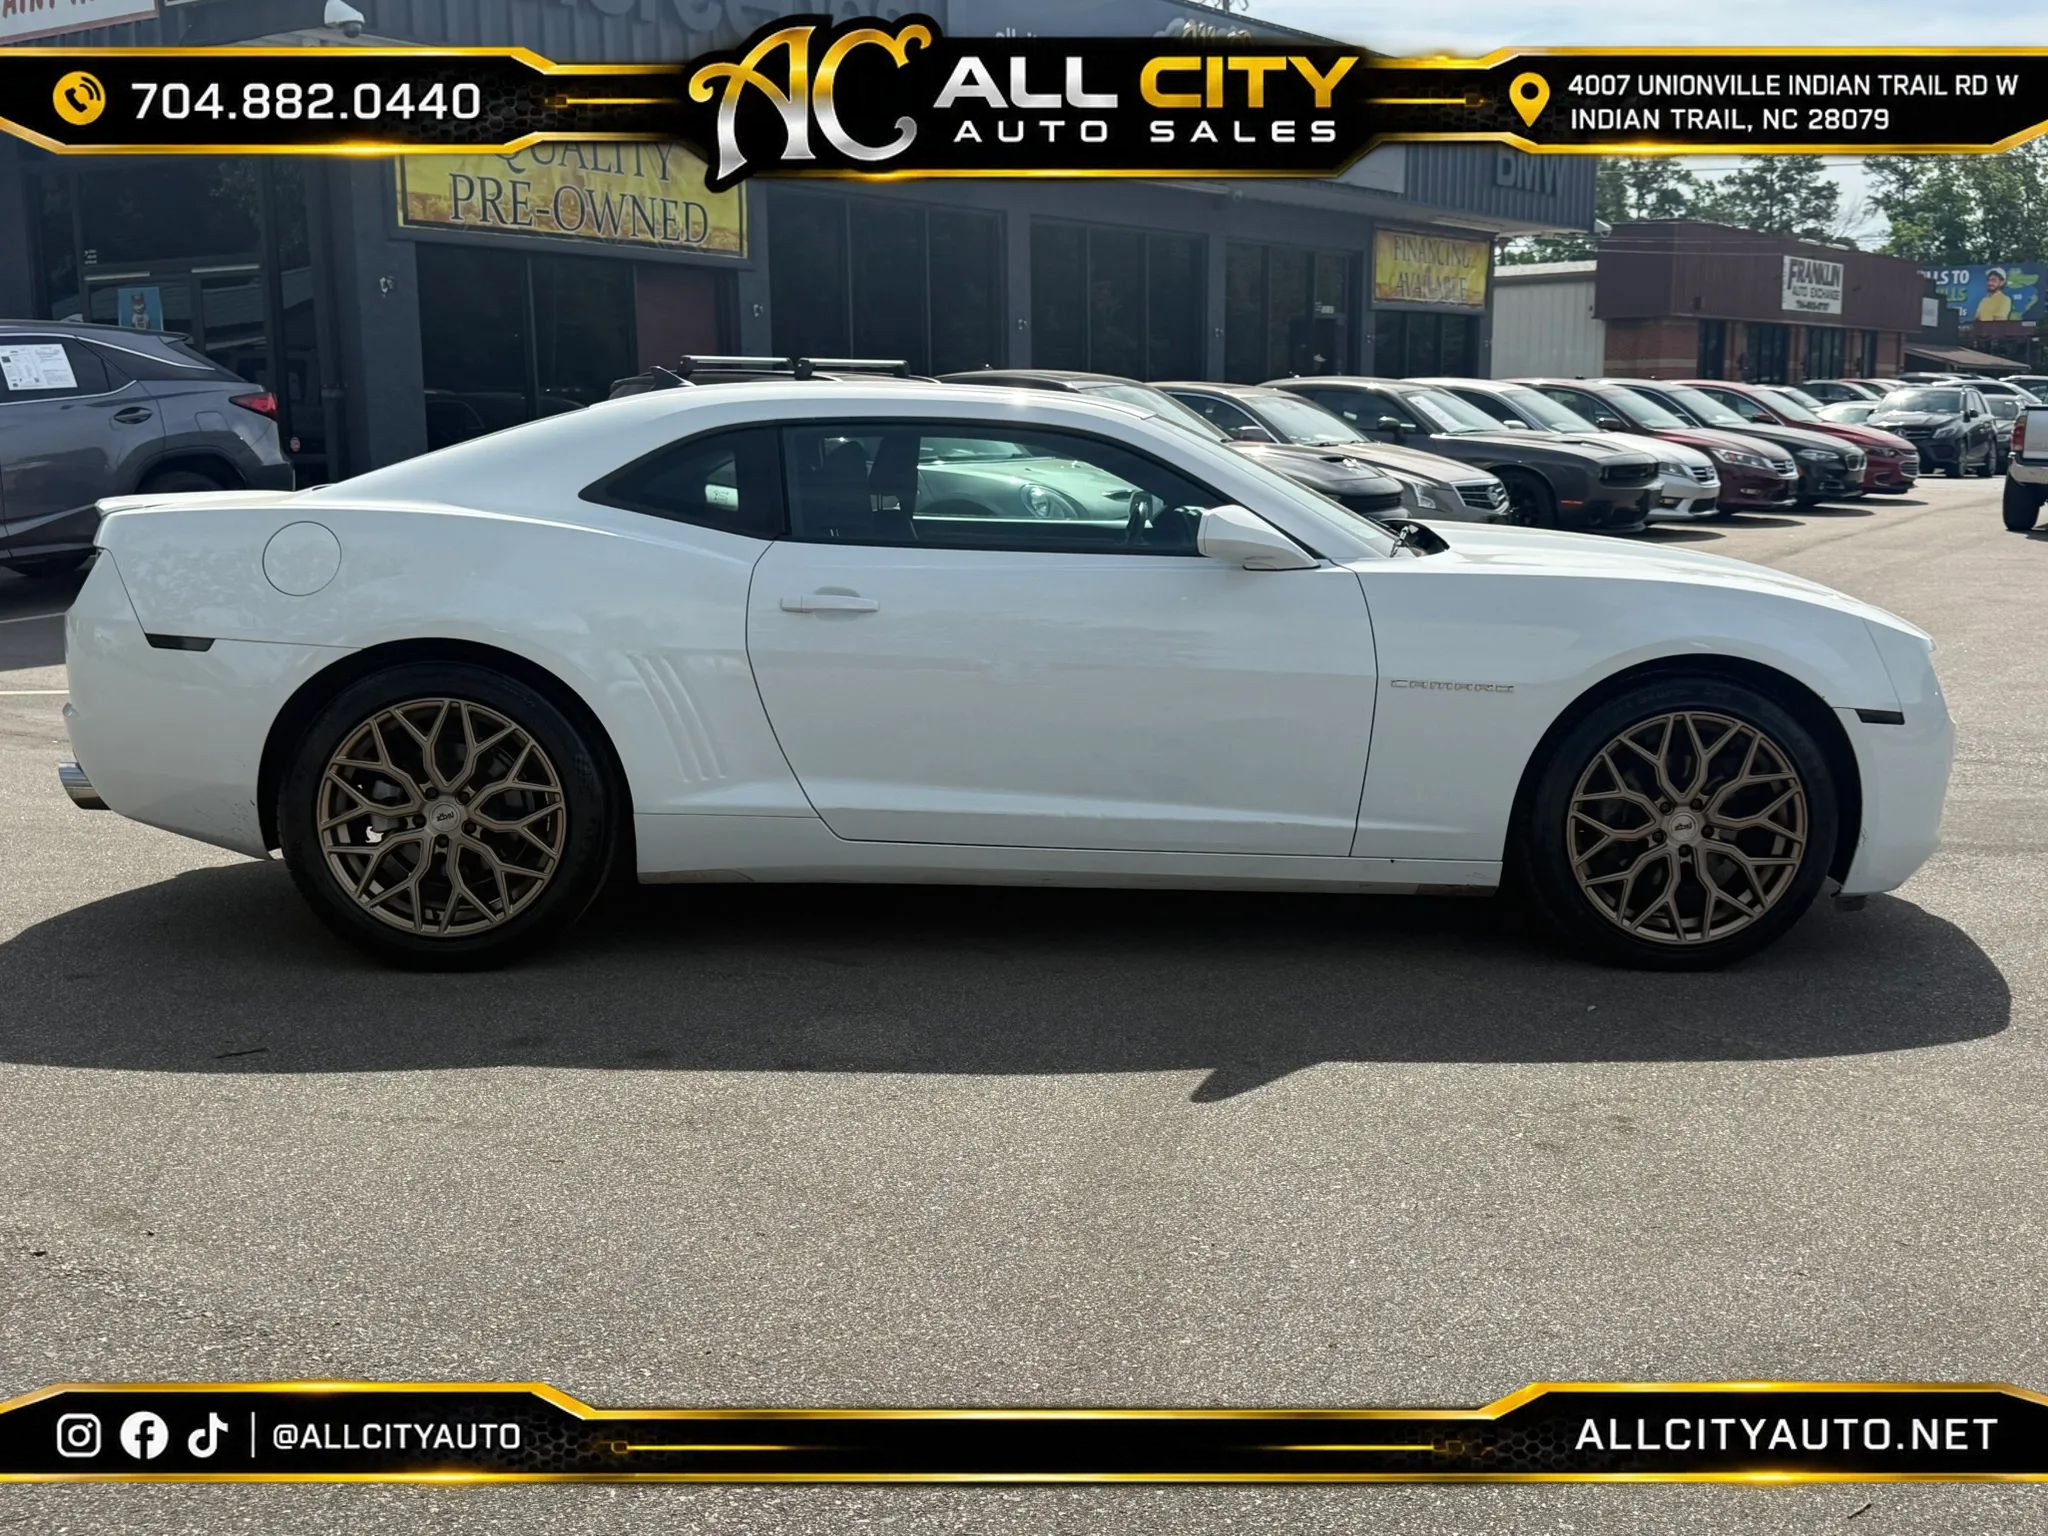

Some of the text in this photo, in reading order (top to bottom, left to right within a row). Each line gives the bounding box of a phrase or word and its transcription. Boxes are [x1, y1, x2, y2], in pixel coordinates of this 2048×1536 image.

[449, 173, 709, 245] PRE-OWNED
[1393, 235, 1470, 268] FINANCING
[1787, 258, 1841, 290] FRANKLIN
[1951, 269, 1970, 285] TO
[1390, 679, 1516, 693] CAMARO
